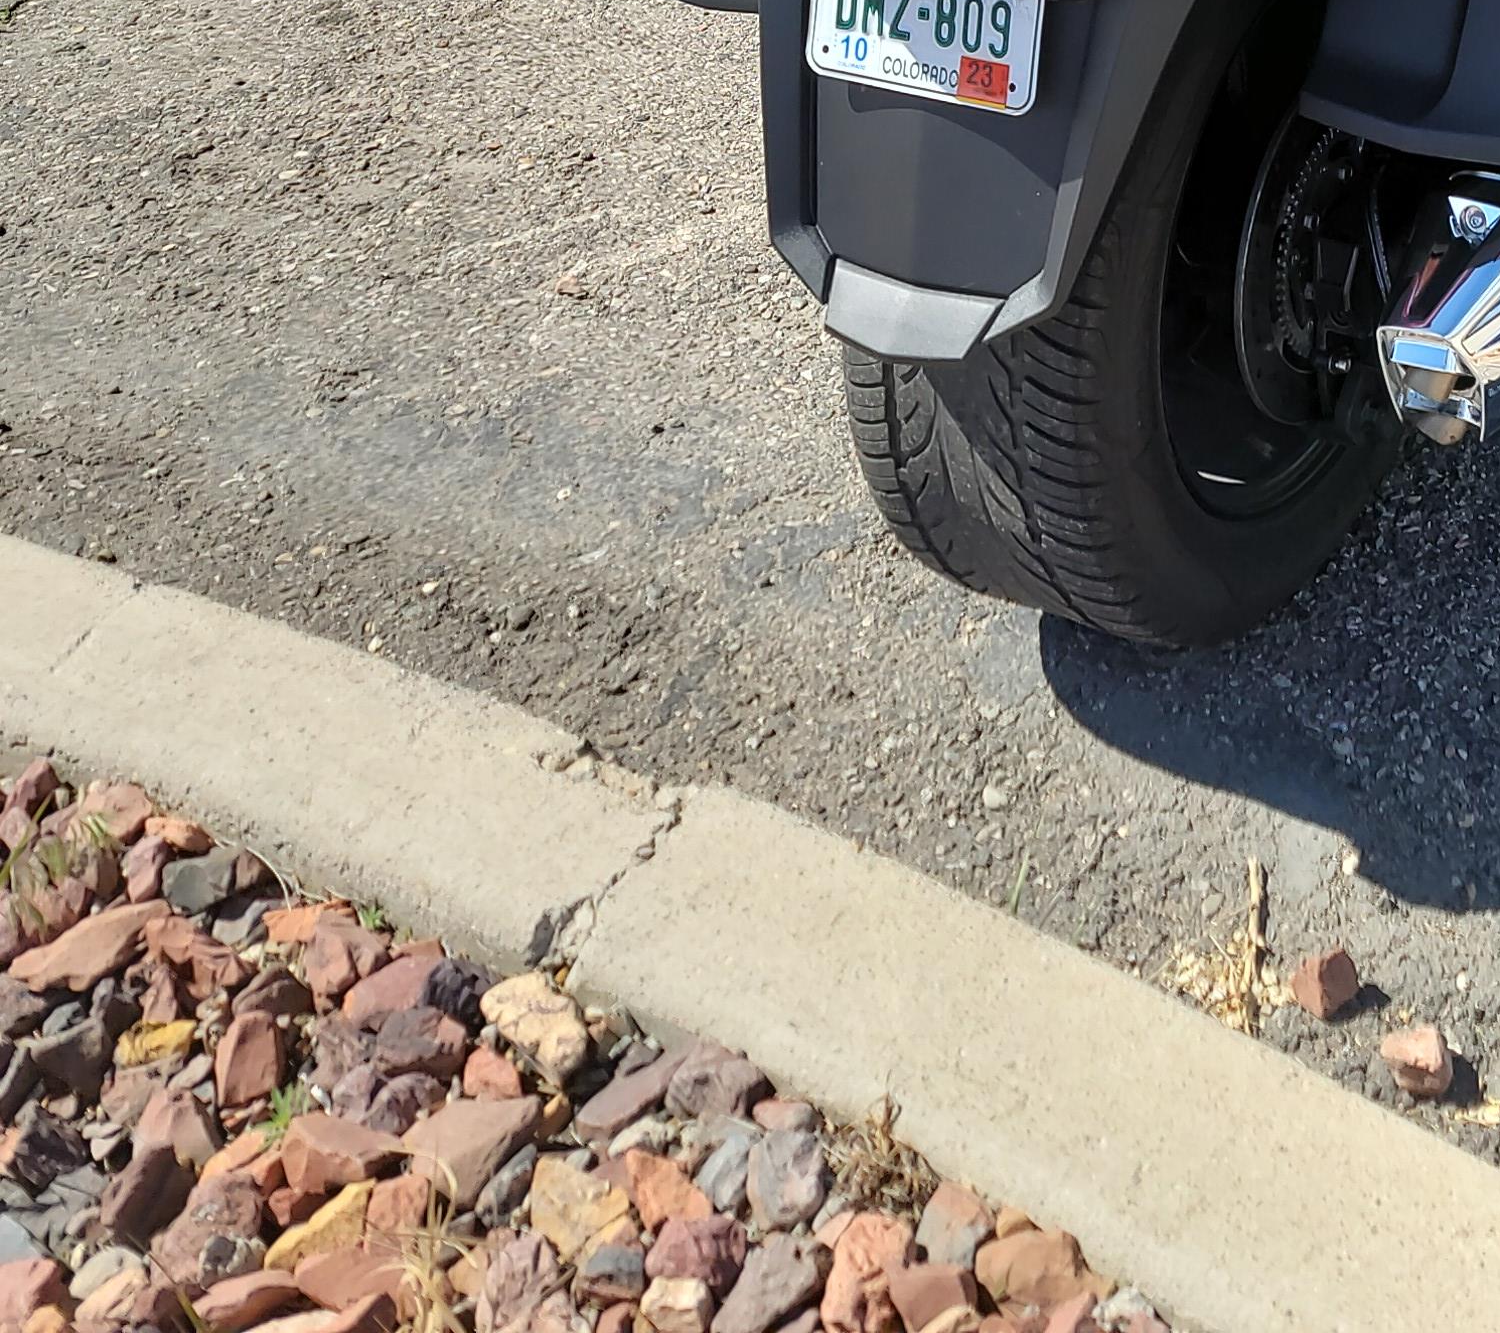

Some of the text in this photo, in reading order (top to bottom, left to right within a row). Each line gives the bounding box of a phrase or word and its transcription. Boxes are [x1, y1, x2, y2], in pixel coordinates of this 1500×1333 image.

[841, 35, 868, 61] 10
[882, 56, 958, 88] COLORADO
[966, 60, 993, 88] 23
